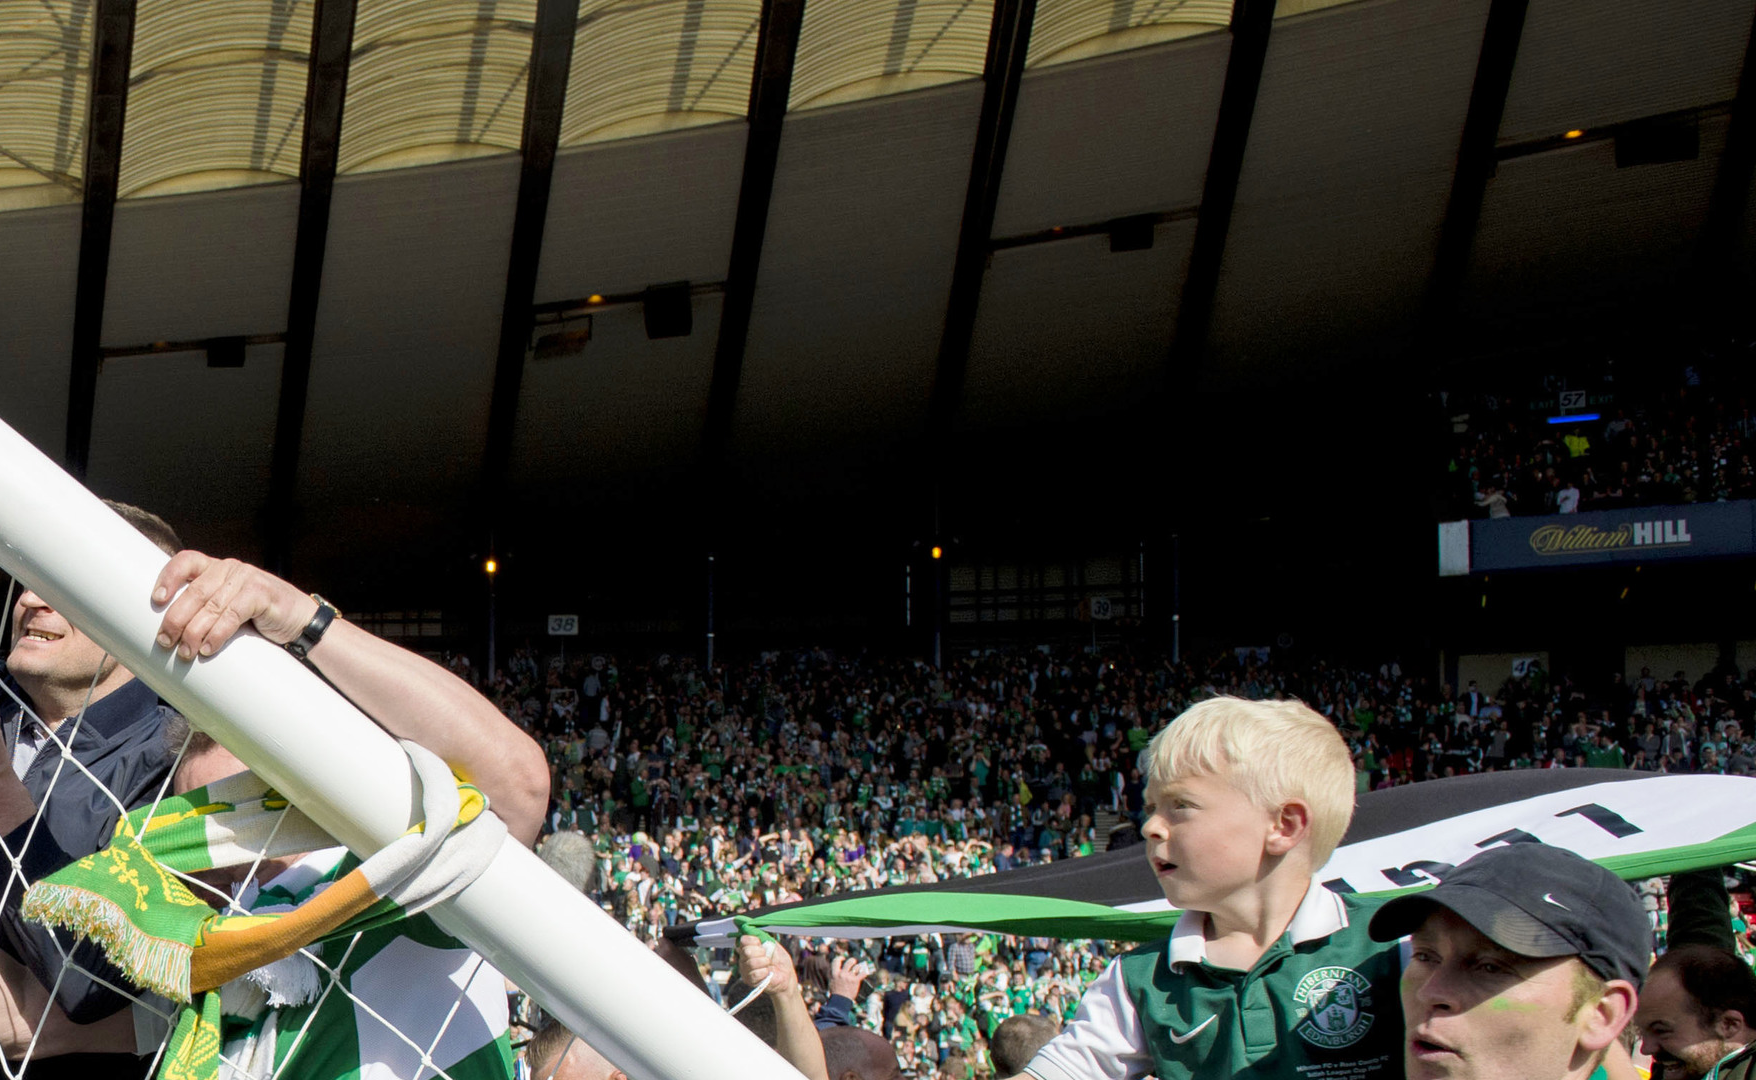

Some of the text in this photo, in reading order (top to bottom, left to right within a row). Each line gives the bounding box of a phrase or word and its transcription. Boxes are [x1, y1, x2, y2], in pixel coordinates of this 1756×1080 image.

[1561, 393, 1583, 407] 57
[1529, 519, 1691, 554] William HILL
[1093, 601, 1109, 615] 39
[551, 617, 575, 632] 38
[1297, 969, 1364, 998] HIBERNIAN
[1305, 1019, 1370, 1046] EDINBURGH
